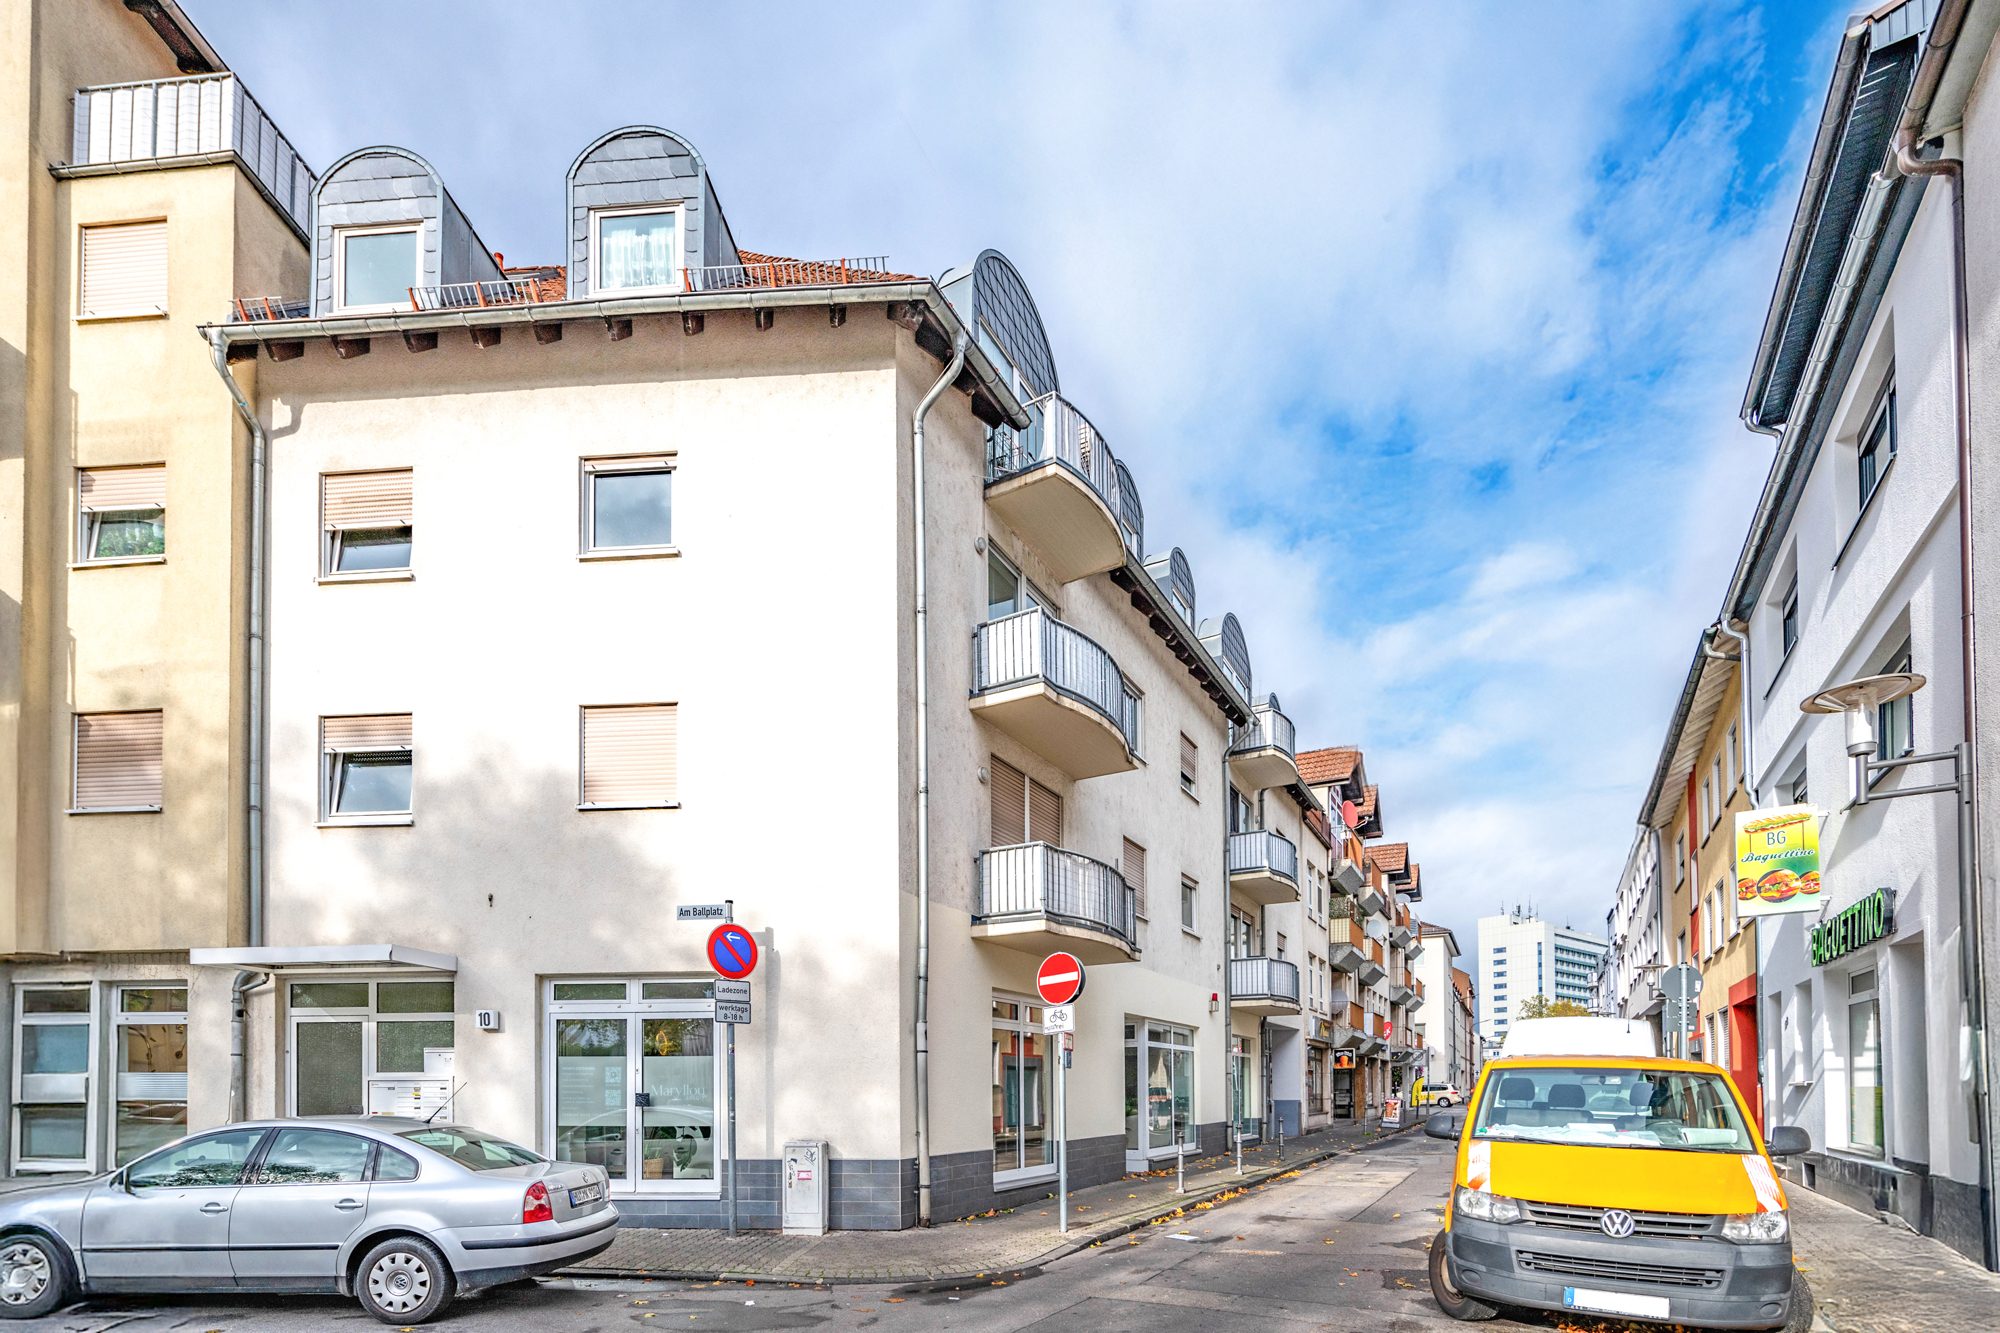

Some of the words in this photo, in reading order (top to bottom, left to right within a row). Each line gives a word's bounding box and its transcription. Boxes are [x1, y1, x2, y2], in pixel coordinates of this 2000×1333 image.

[1767, 830, 1786, 846] BG
[1741, 848, 1815, 863] Baguettino
[679, 907, 691, 916] Am
[692, 908, 723, 918] Ballplatz
[1811, 887, 1885, 967] BAGUETTINO
[718, 986, 748, 995] Ladezone
[718, 1005, 748, 1014] werktags
[478, 1012, 491, 1027] 10
[651, 1084, 705, 1097] Maryllou
[1602, 1210, 1634, 1238] VW
